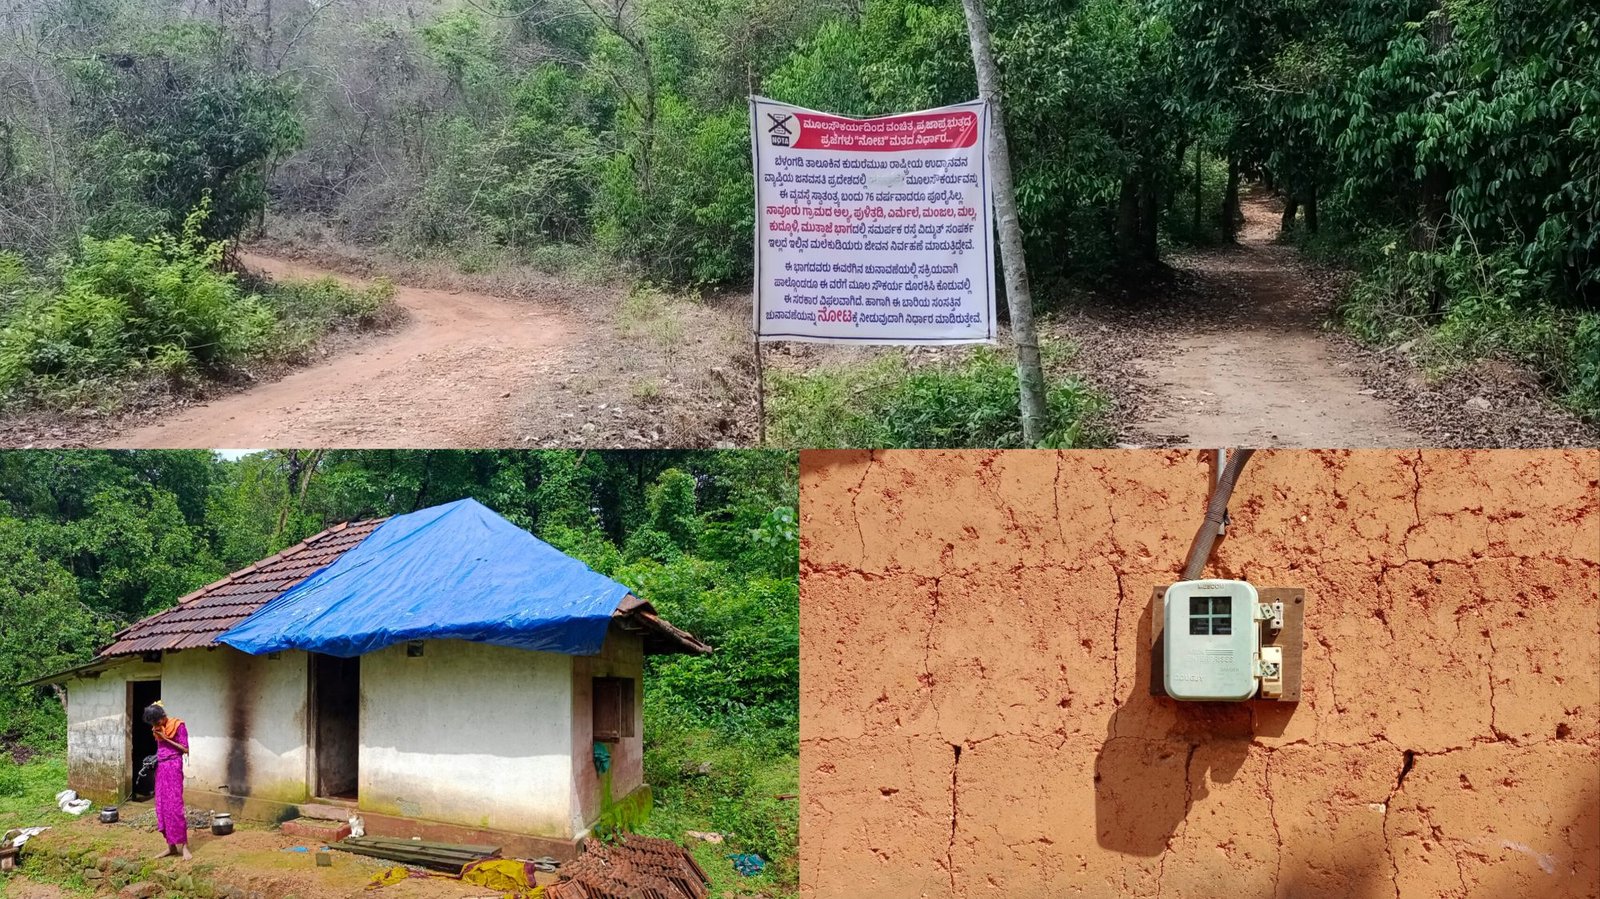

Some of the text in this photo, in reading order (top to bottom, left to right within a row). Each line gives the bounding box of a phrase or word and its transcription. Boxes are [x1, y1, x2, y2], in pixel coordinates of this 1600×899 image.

[803, 119, 885, 132] ಮೂಲಸೌಕರ್ಯದಿಂದ
[772, 136, 789, 145] NOTA
[806, 158, 840, 168] ತಾಲೂಕಿನ
[842, 159, 888, 169] ಕುದುರೆಮುಖ
[925, 157, 968, 173] ಉದ್ಯಾನವನ
[795, 174, 826, 184] ಜನವಸತಿ
[828, 173, 868, 189] ಪ್ರದೇಶದಲ್ಲಿ
[780, 189, 788, 198] ಈ
[841, 192, 863, 201] ಬಂದು
[866, 192, 874, 201] 76
[876, 191, 926, 201] ವರ್ಷವಾದರೂ
[803, 206, 832, 219] ಗ್ರಾಮದ
[868, 224, 902, 234] ಸಮರ್ಪಕ
[904, 223, 917, 238] ರಸ್ತೆ
[945, 223, 974, 234] ಸಂಪರ್ಕ
[864, 240, 888, 250] ಜೀವನ
[785, 261, 792, 271] ಈ
[794, 262, 831, 274] ಭಾಗದವರು
[918, 263, 958, 277] ಸಕ್ರಿಯವಾಗಿ
[820, 279, 828, 289] ಈ
[829, 278, 847, 289] ವರೆಗೆ
[849, 280, 870, 290] ಮೂಲ
[784, 293, 791, 303] ಈ
[793, 294, 818, 305] ಸರಕಾರ
[865, 296, 890, 307] ಹಾಗಾಗಿ
[893, 297, 900, 307] ಈ
[902, 296, 930, 307] ಬಾರಿಯ
